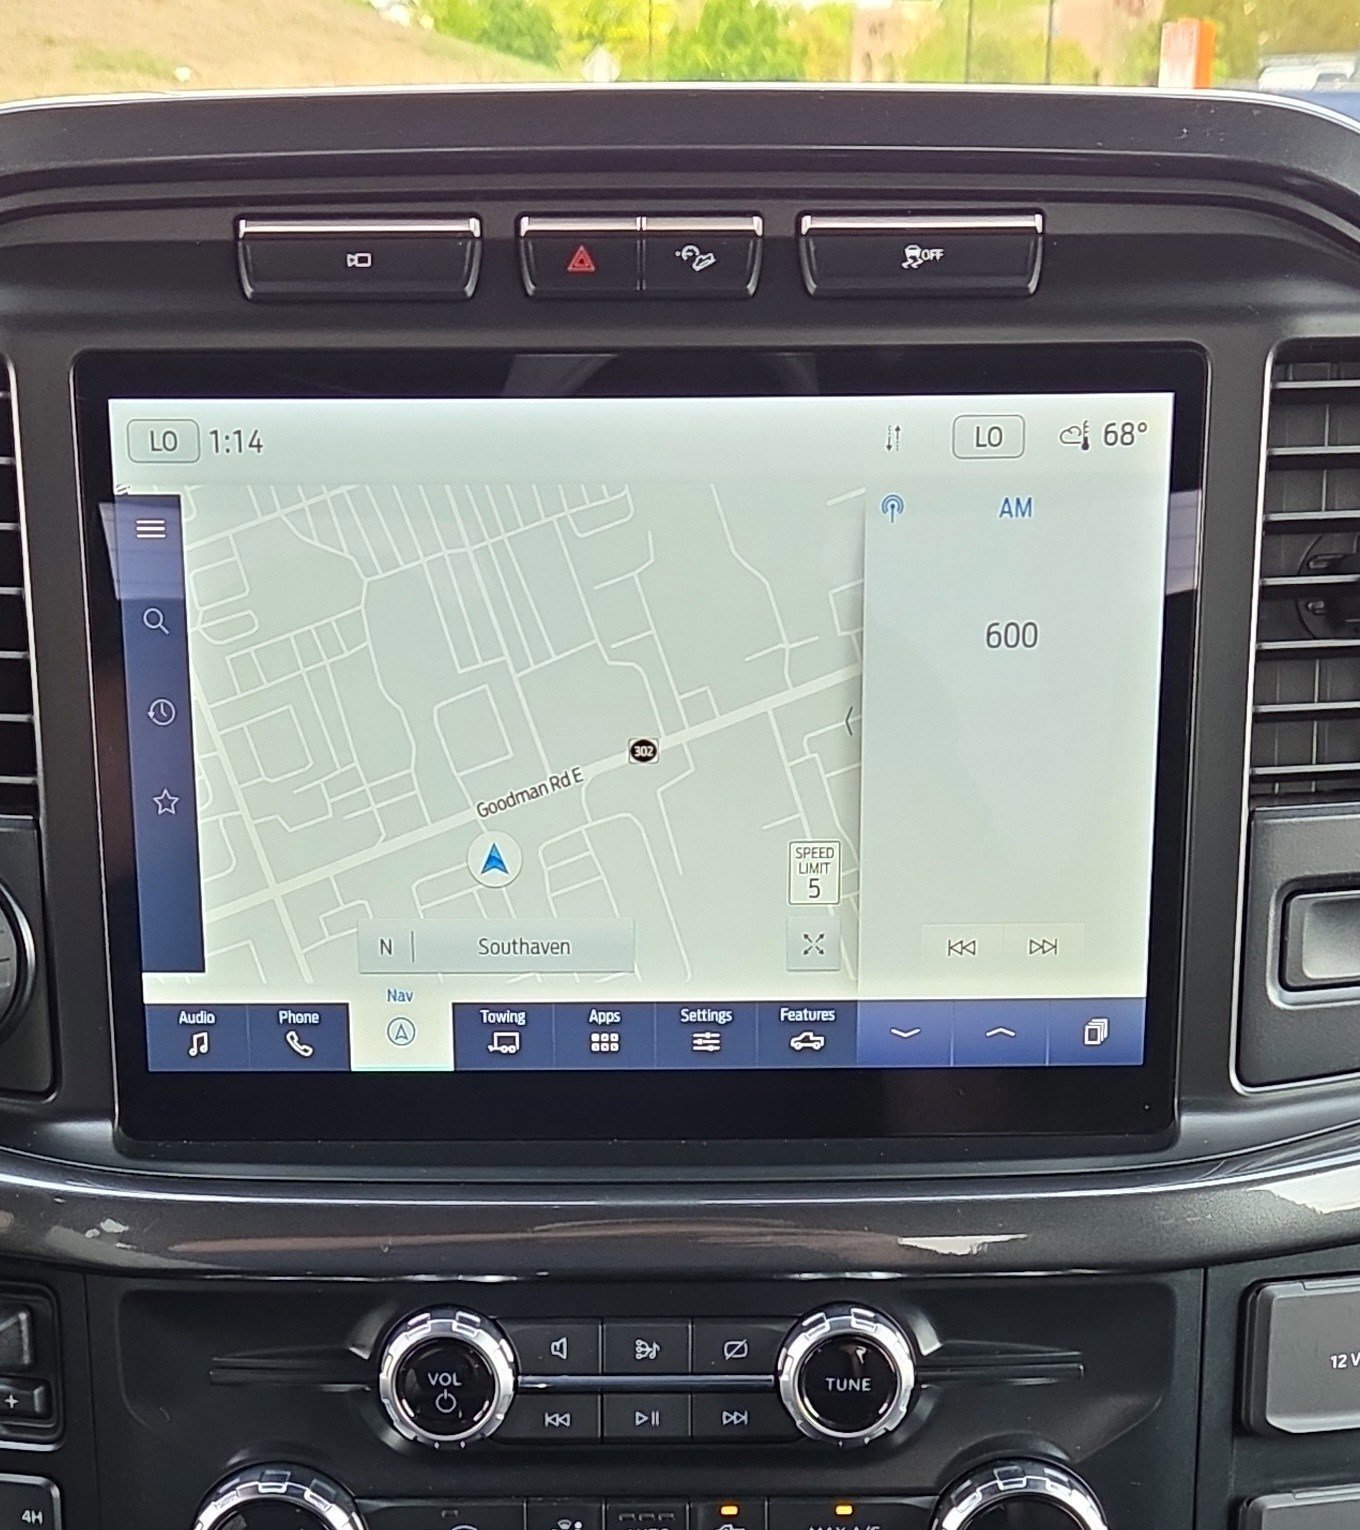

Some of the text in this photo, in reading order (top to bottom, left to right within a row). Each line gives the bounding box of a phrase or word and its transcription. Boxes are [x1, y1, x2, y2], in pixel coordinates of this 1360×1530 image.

[921, 248, 944, 261] OFF
[149, 430, 179, 452] LO
[209, 429, 264, 455] 1:14
[975, 426, 1004, 448] LO
[1102, 421, 1148, 446] 68°
[998, 497, 1033, 519] AM
[985, 621, 1039, 650] 600
[634, 744, 654, 759] 302
[476, 767, 585, 818] Goodman Rd E
[794, 845, 835, 861] SPEED
[798, 862, 831, 876] LIMIT
[807, 878, 821, 899] 5
[379, 938, 393, 956] N
[478, 936, 572, 957] Southaven
[386, 988, 415, 1003] Nav
[178, 1010, 216, 1025] Audio
[278, 1010, 320, 1025] Phone
[479, 1009, 527, 1027] Towing
[588, 1008, 621, 1027] Apps
[680, 1007, 733, 1025] Settings
[780, 1007, 836, 1023] Features
[1329, 1353, 1349, 1369] 12
[427, 1372, 462, 1388] VOL
[825, 1377, 872, 1392] TUNE
[21, 1509, 44, 1526] 4H
